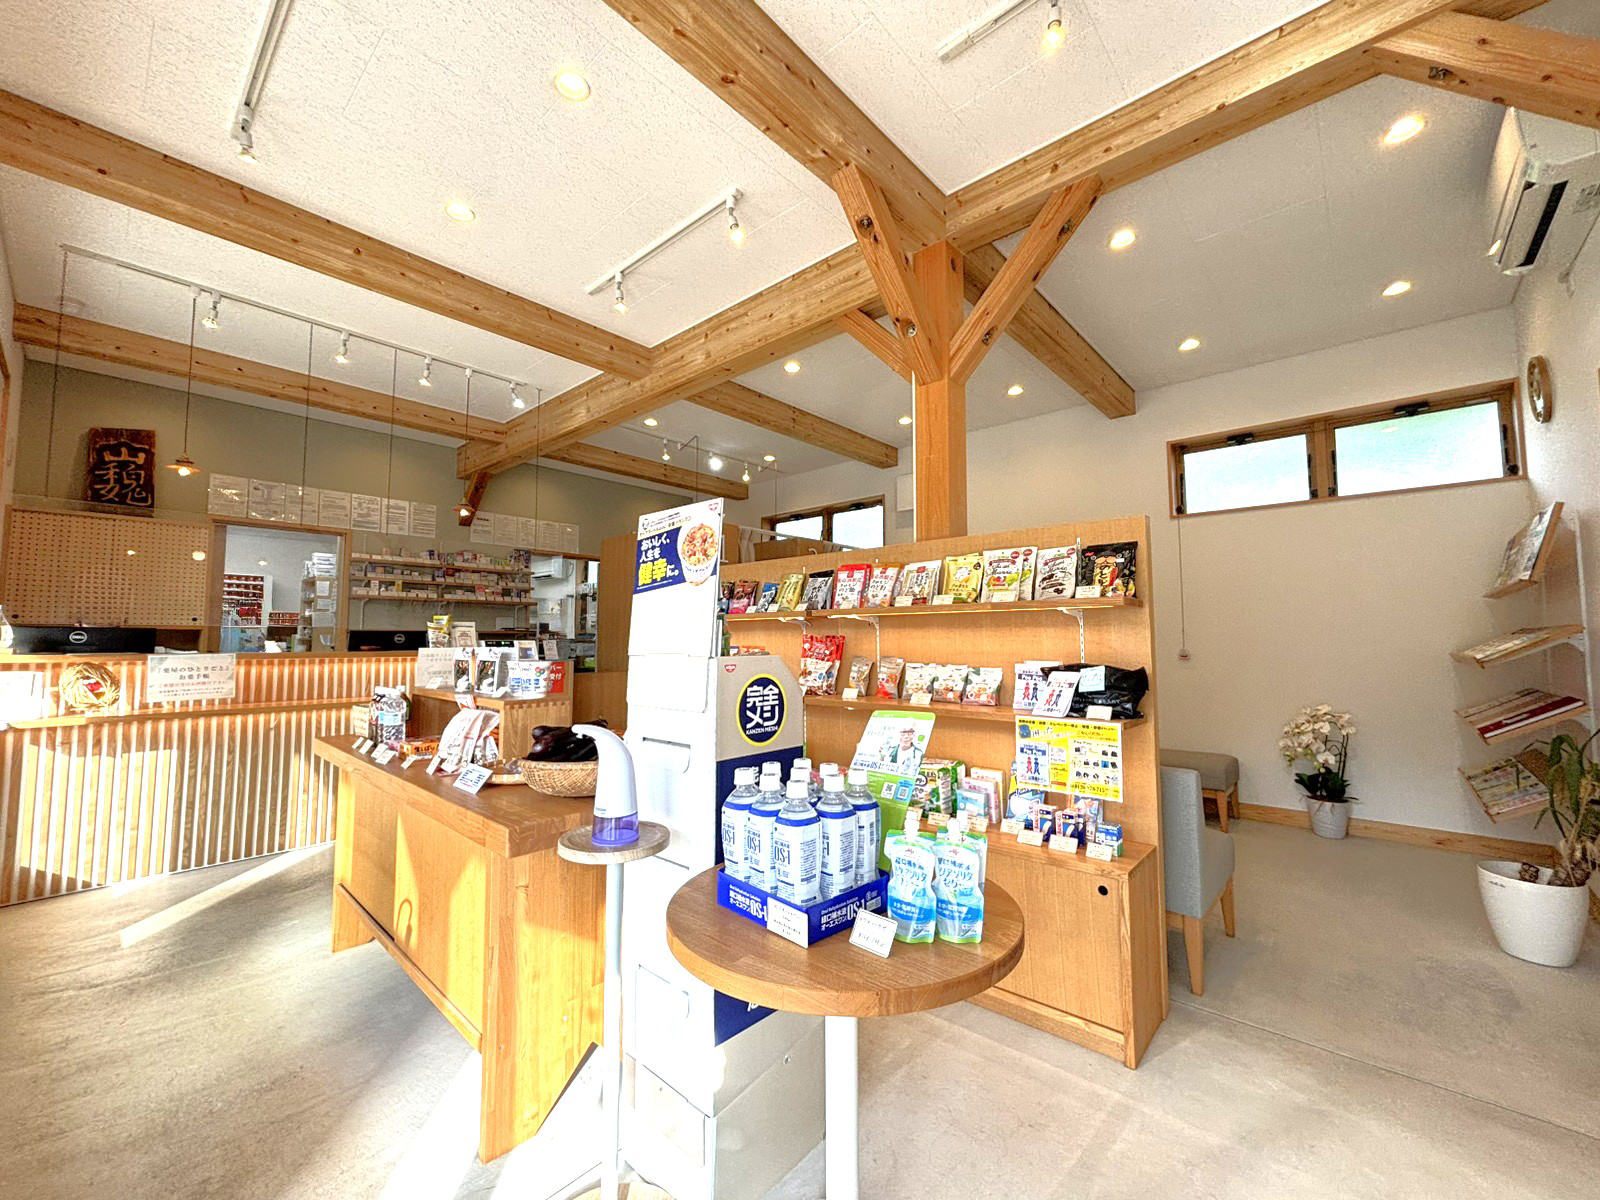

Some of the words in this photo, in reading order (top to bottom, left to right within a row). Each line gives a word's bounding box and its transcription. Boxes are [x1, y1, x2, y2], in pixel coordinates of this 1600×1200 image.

[640, 532, 671, 551] おいしく、
[639, 547, 661, 563] 人生を
[178, 673, 210, 681] お薬手帳
[746, 684, 779, 708] 完全
[746, 705, 779, 729] メシ
[746, 727, 765, 735] KANZEN
[722, 828, 735, 845] OS-1
[747, 835, 761, 853] OS-1
[774, 845, 790, 865] OS-1
[750, 899, 768, 922] OS-1
[821, 907, 847, 924] 経口補水液
[820, 915, 848, 931] オーエスワン
